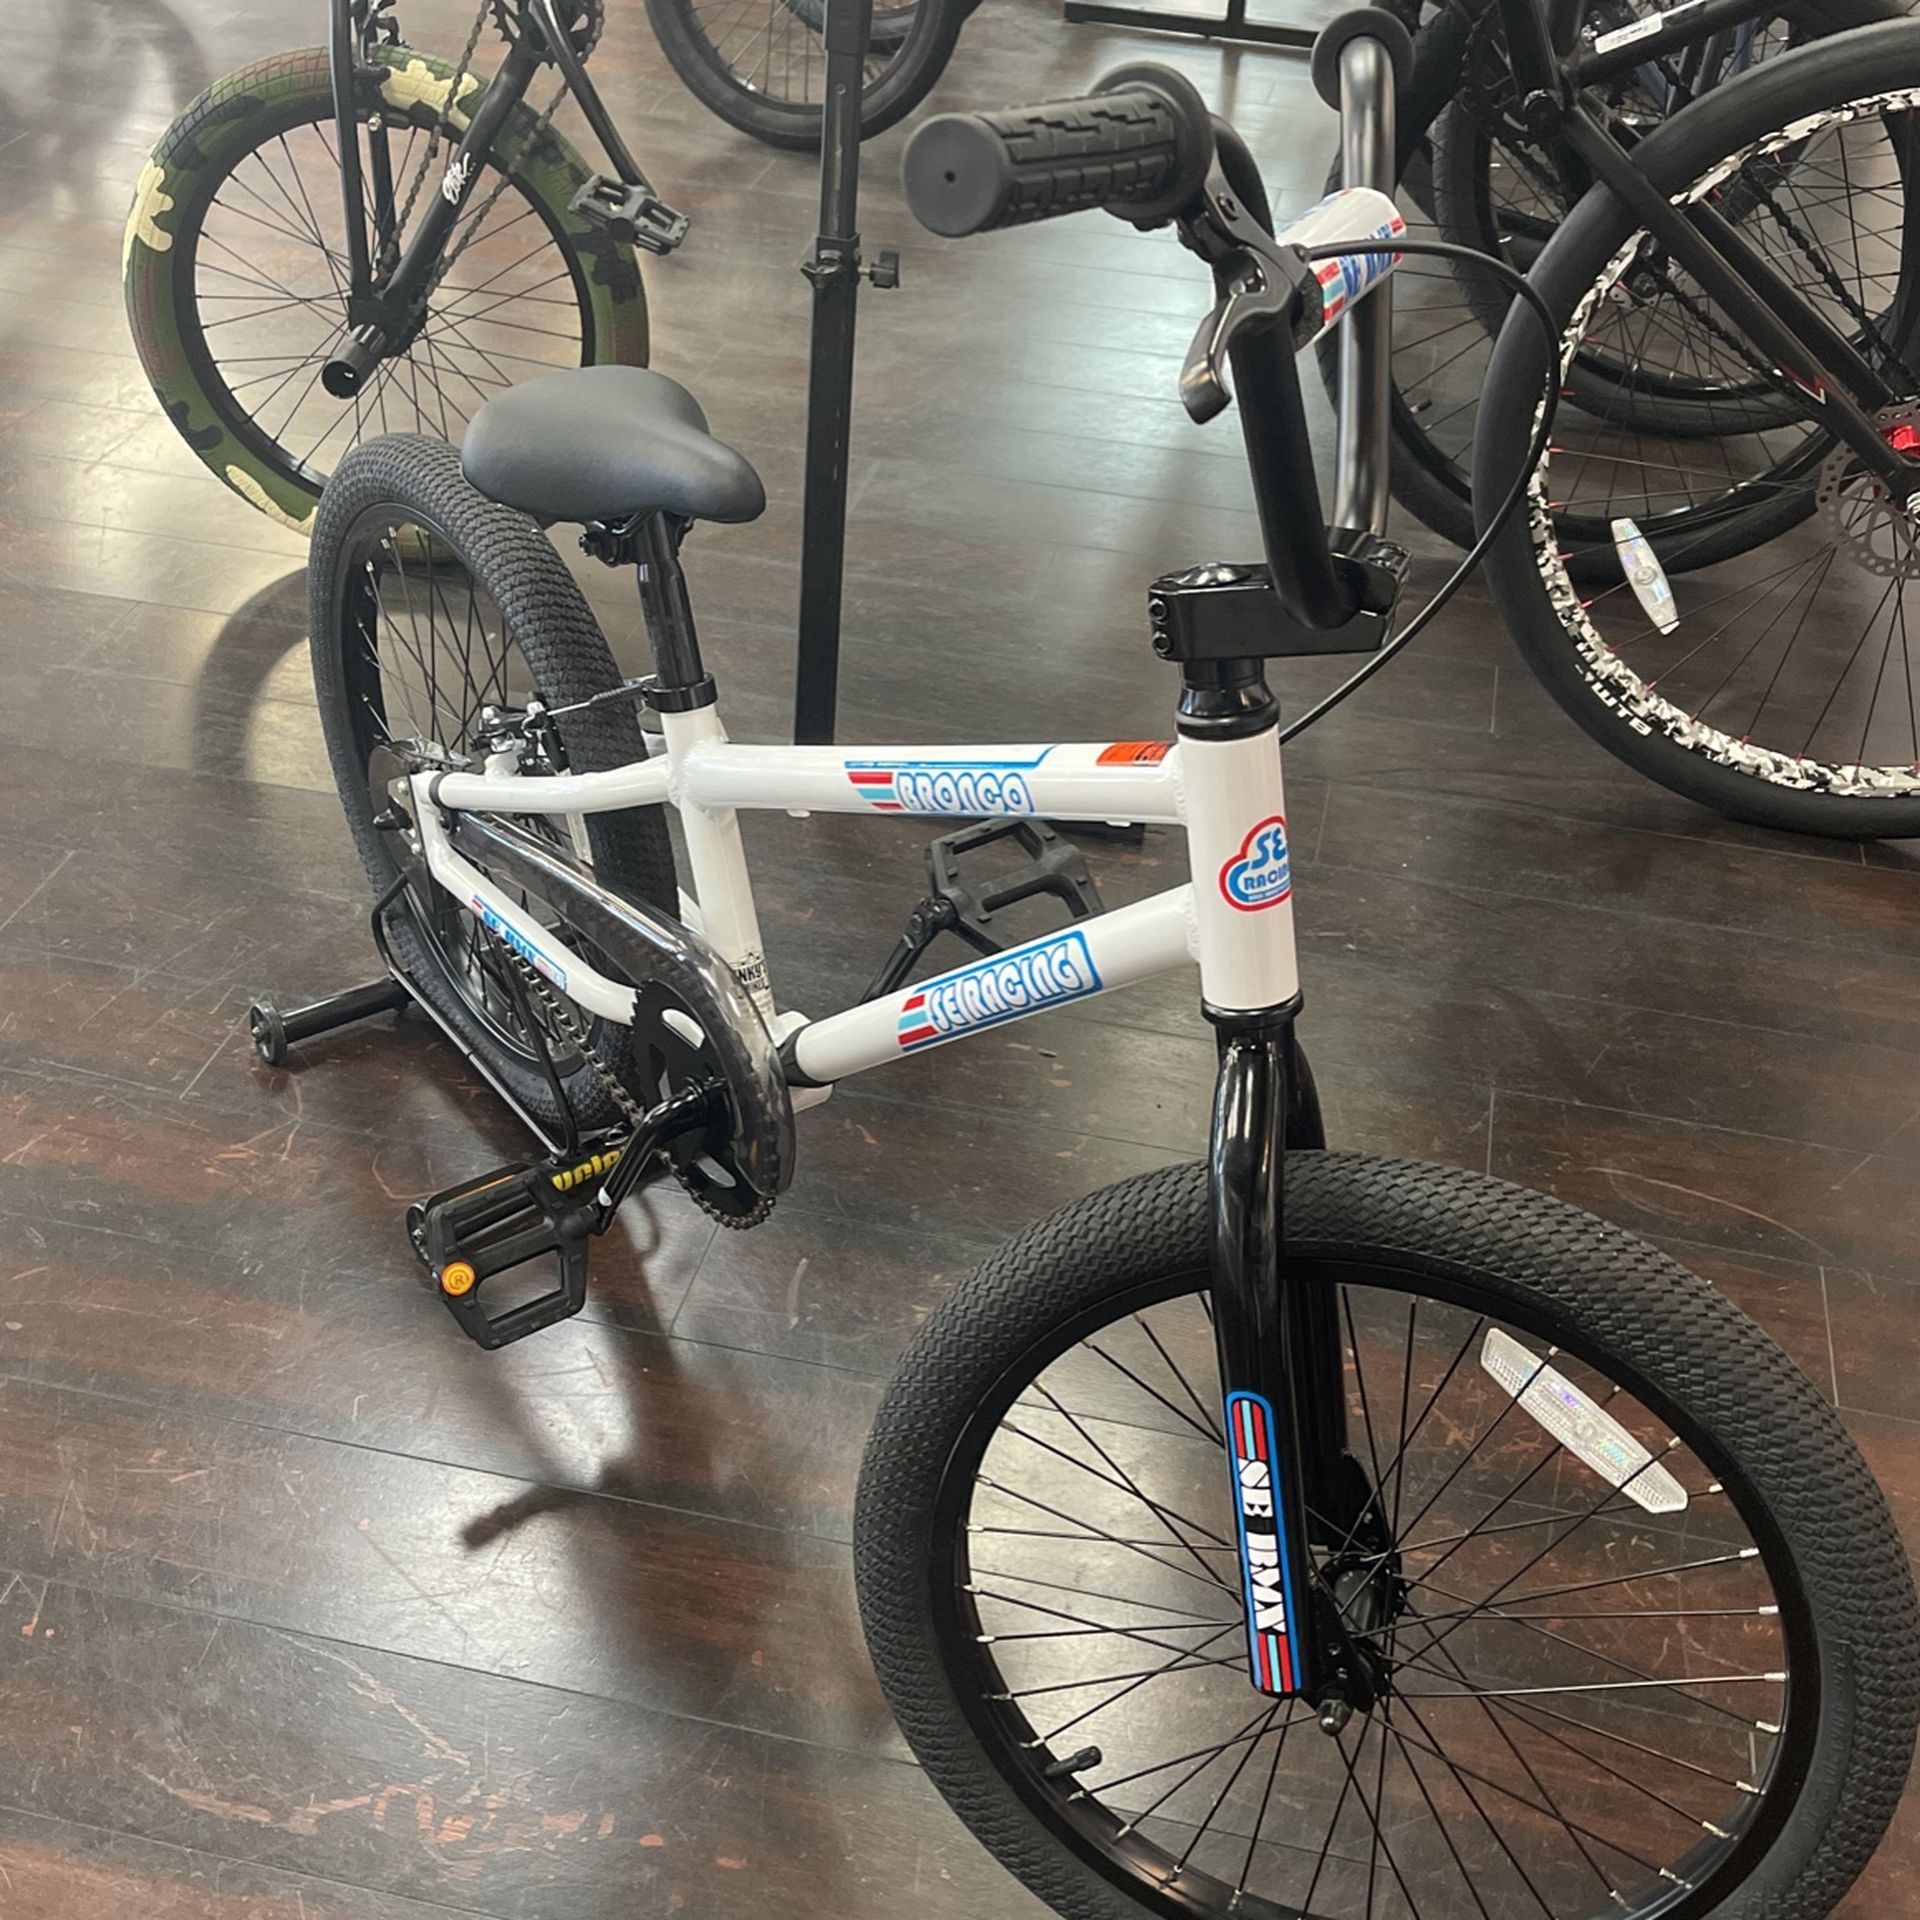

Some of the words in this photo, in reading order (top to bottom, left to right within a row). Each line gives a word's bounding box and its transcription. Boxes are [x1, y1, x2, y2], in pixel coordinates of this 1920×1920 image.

[1591, 682, 1652, 736] WTB
[896, 772, 1035, 814] BRONCO
[1250, 827, 1288, 870] SE
[1238, 1458, 1273, 1517] SE
[1246, 1532, 1287, 1634] BMX
